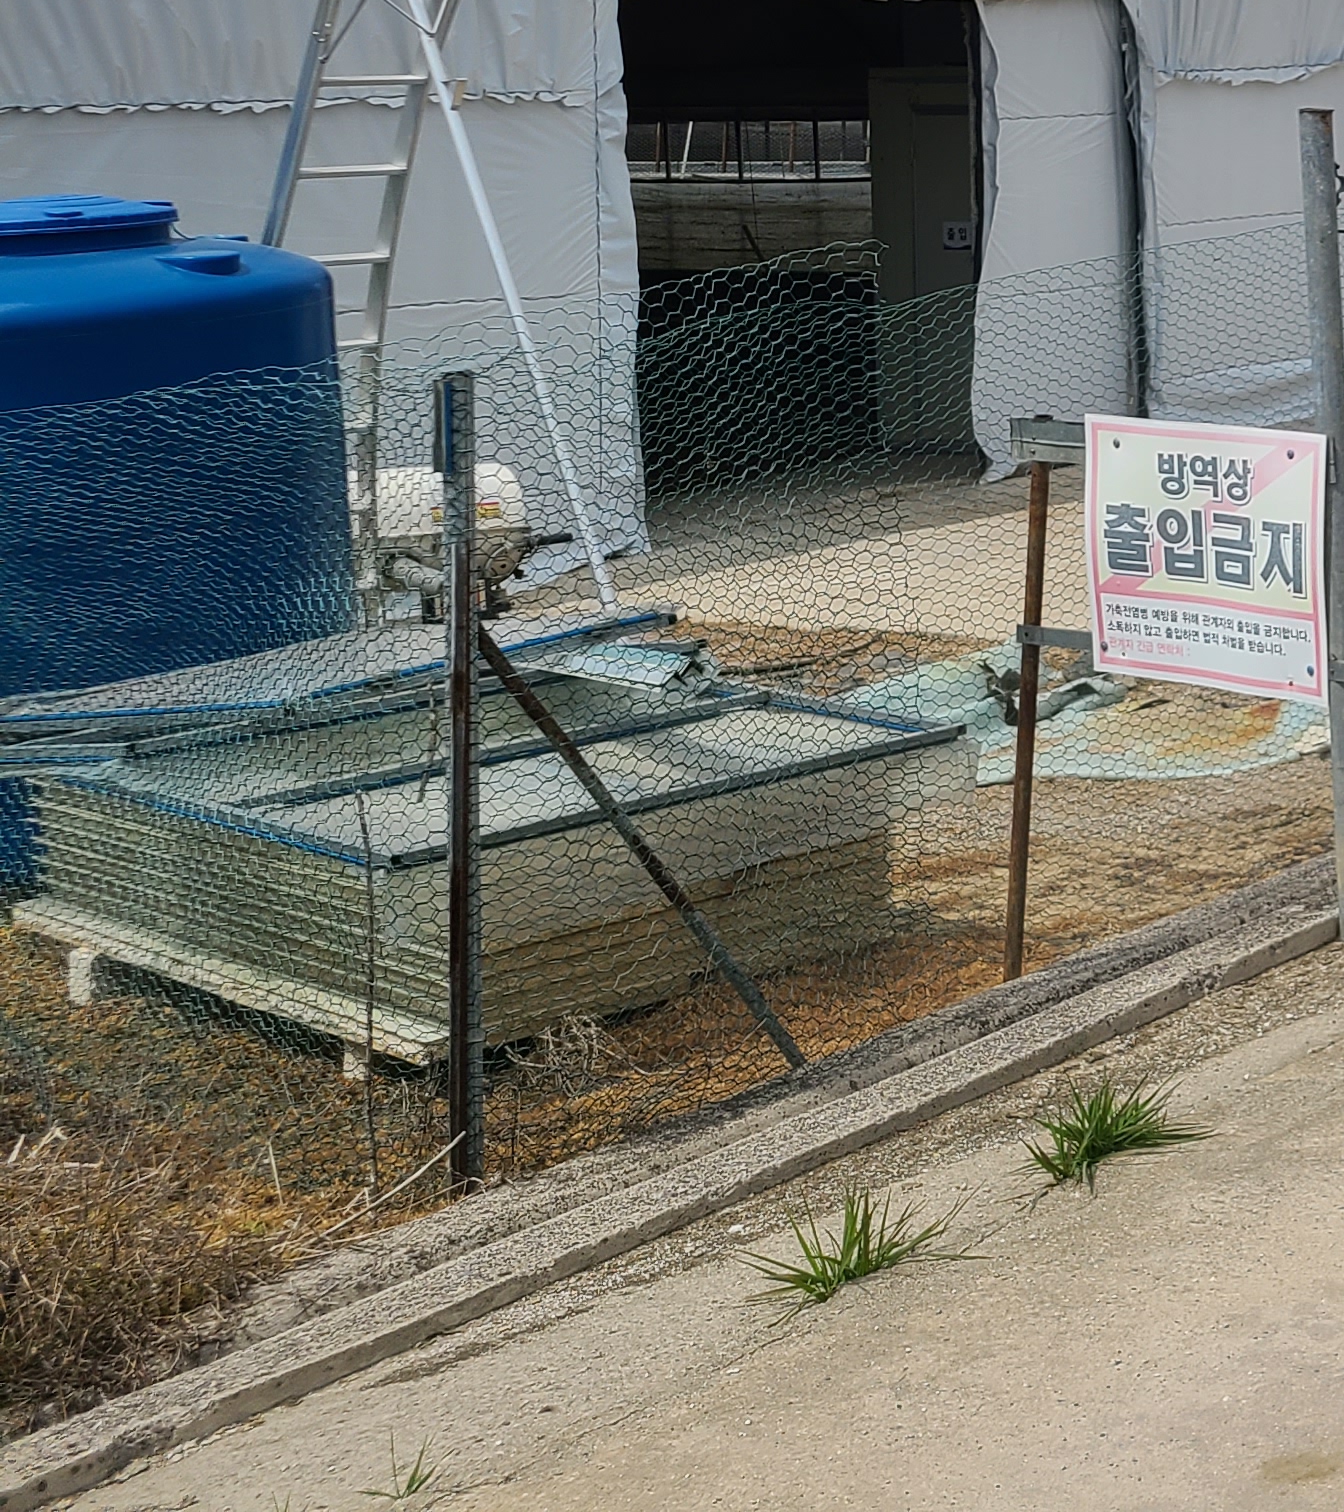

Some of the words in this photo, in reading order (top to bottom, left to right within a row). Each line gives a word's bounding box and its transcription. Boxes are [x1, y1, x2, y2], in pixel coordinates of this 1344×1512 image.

[1157, 453, 1253, 503] 방역상
[1104, 503, 1306, 596] 출입금지
[1105, 603, 1148, 619] 가축전염병
[1151, 609, 1178, 622] 예방을
[1181, 611, 1199, 625] 위해
[1237, 620, 1260, 635] 출입을
[1263, 625, 1311, 643] 금지합니다.
[1107, 620, 1141, 635] 소독하지
[1144, 625, 1161, 636] 않고
[1165, 627, 1200, 642] 출입하면
[1203, 632, 1219, 645] 법적
[1222, 635, 1245, 650] 처벌을
[1248, 640, 1286, 656] 받습니다.
